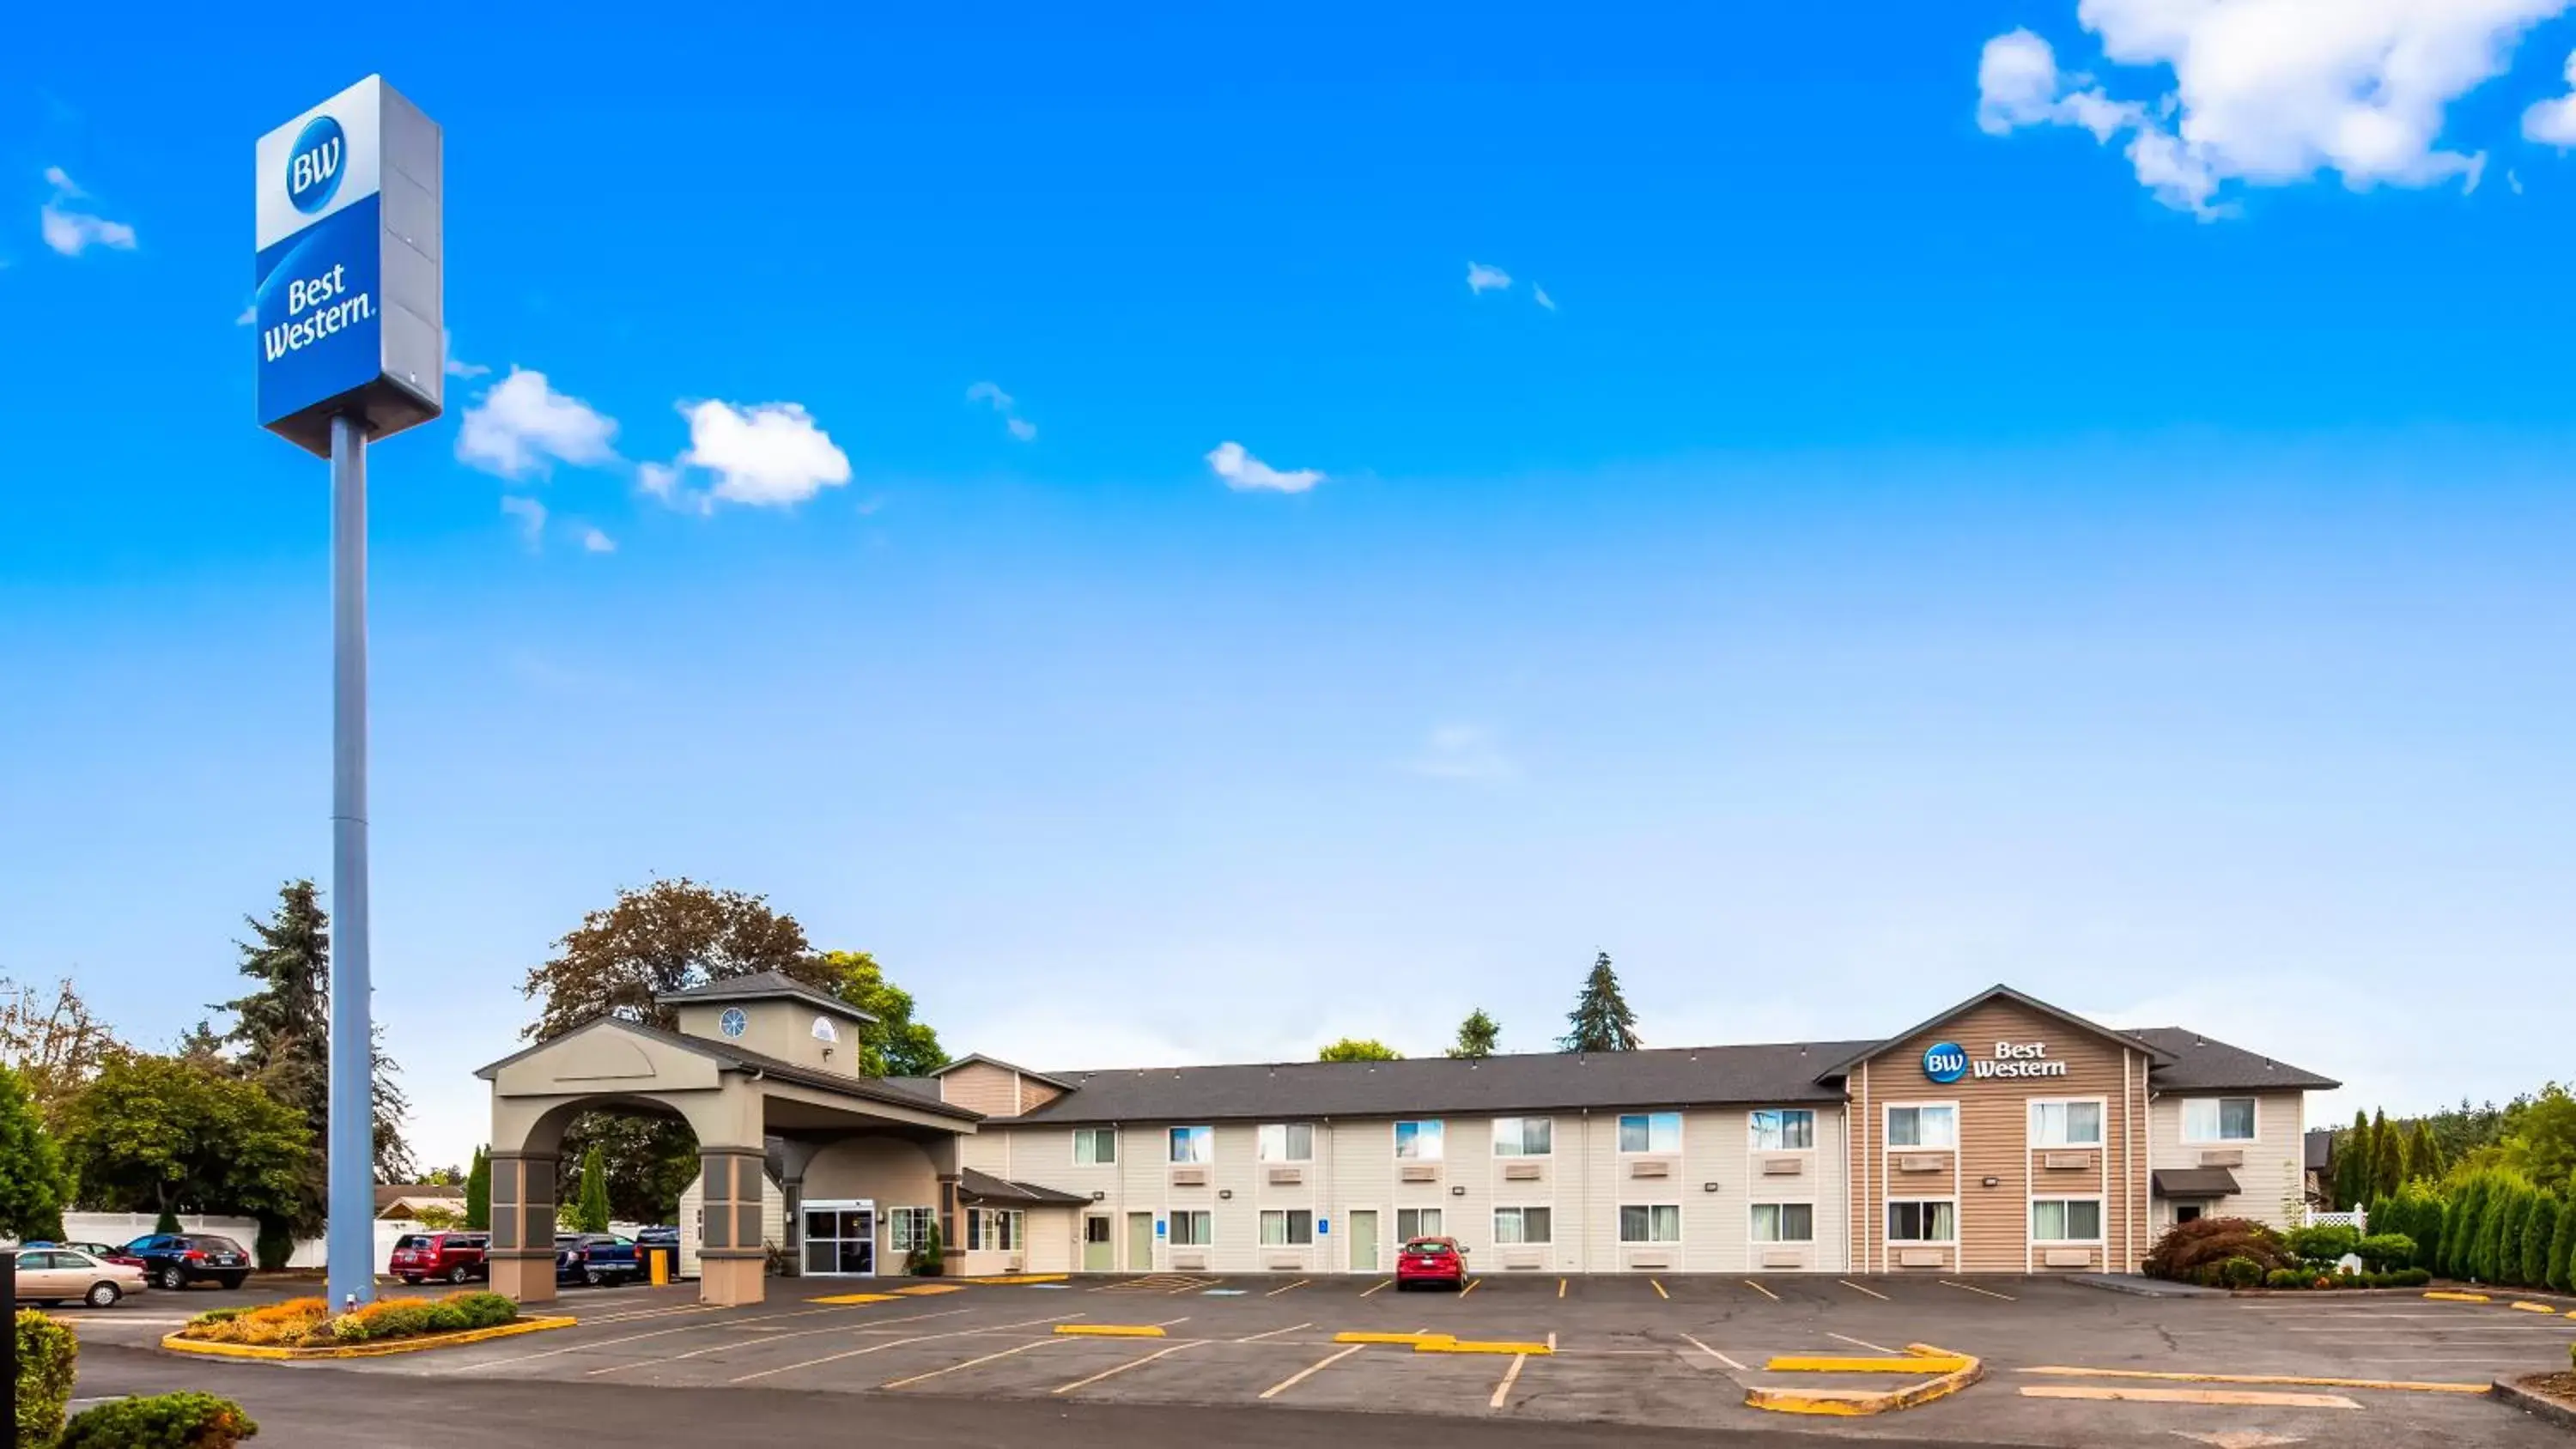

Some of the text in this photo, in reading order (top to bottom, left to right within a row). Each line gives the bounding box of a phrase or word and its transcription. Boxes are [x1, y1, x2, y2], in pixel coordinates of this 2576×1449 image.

[294, 136, 340, 195] BW
[289, 263, 345, 316] Best
[264, 292, 369, 363] Western
[1928, 1054, 1964, 1072] BW
[1995, 1041, 2046, 1059] Best
[1973, 1059, 2067, 1078] Western
